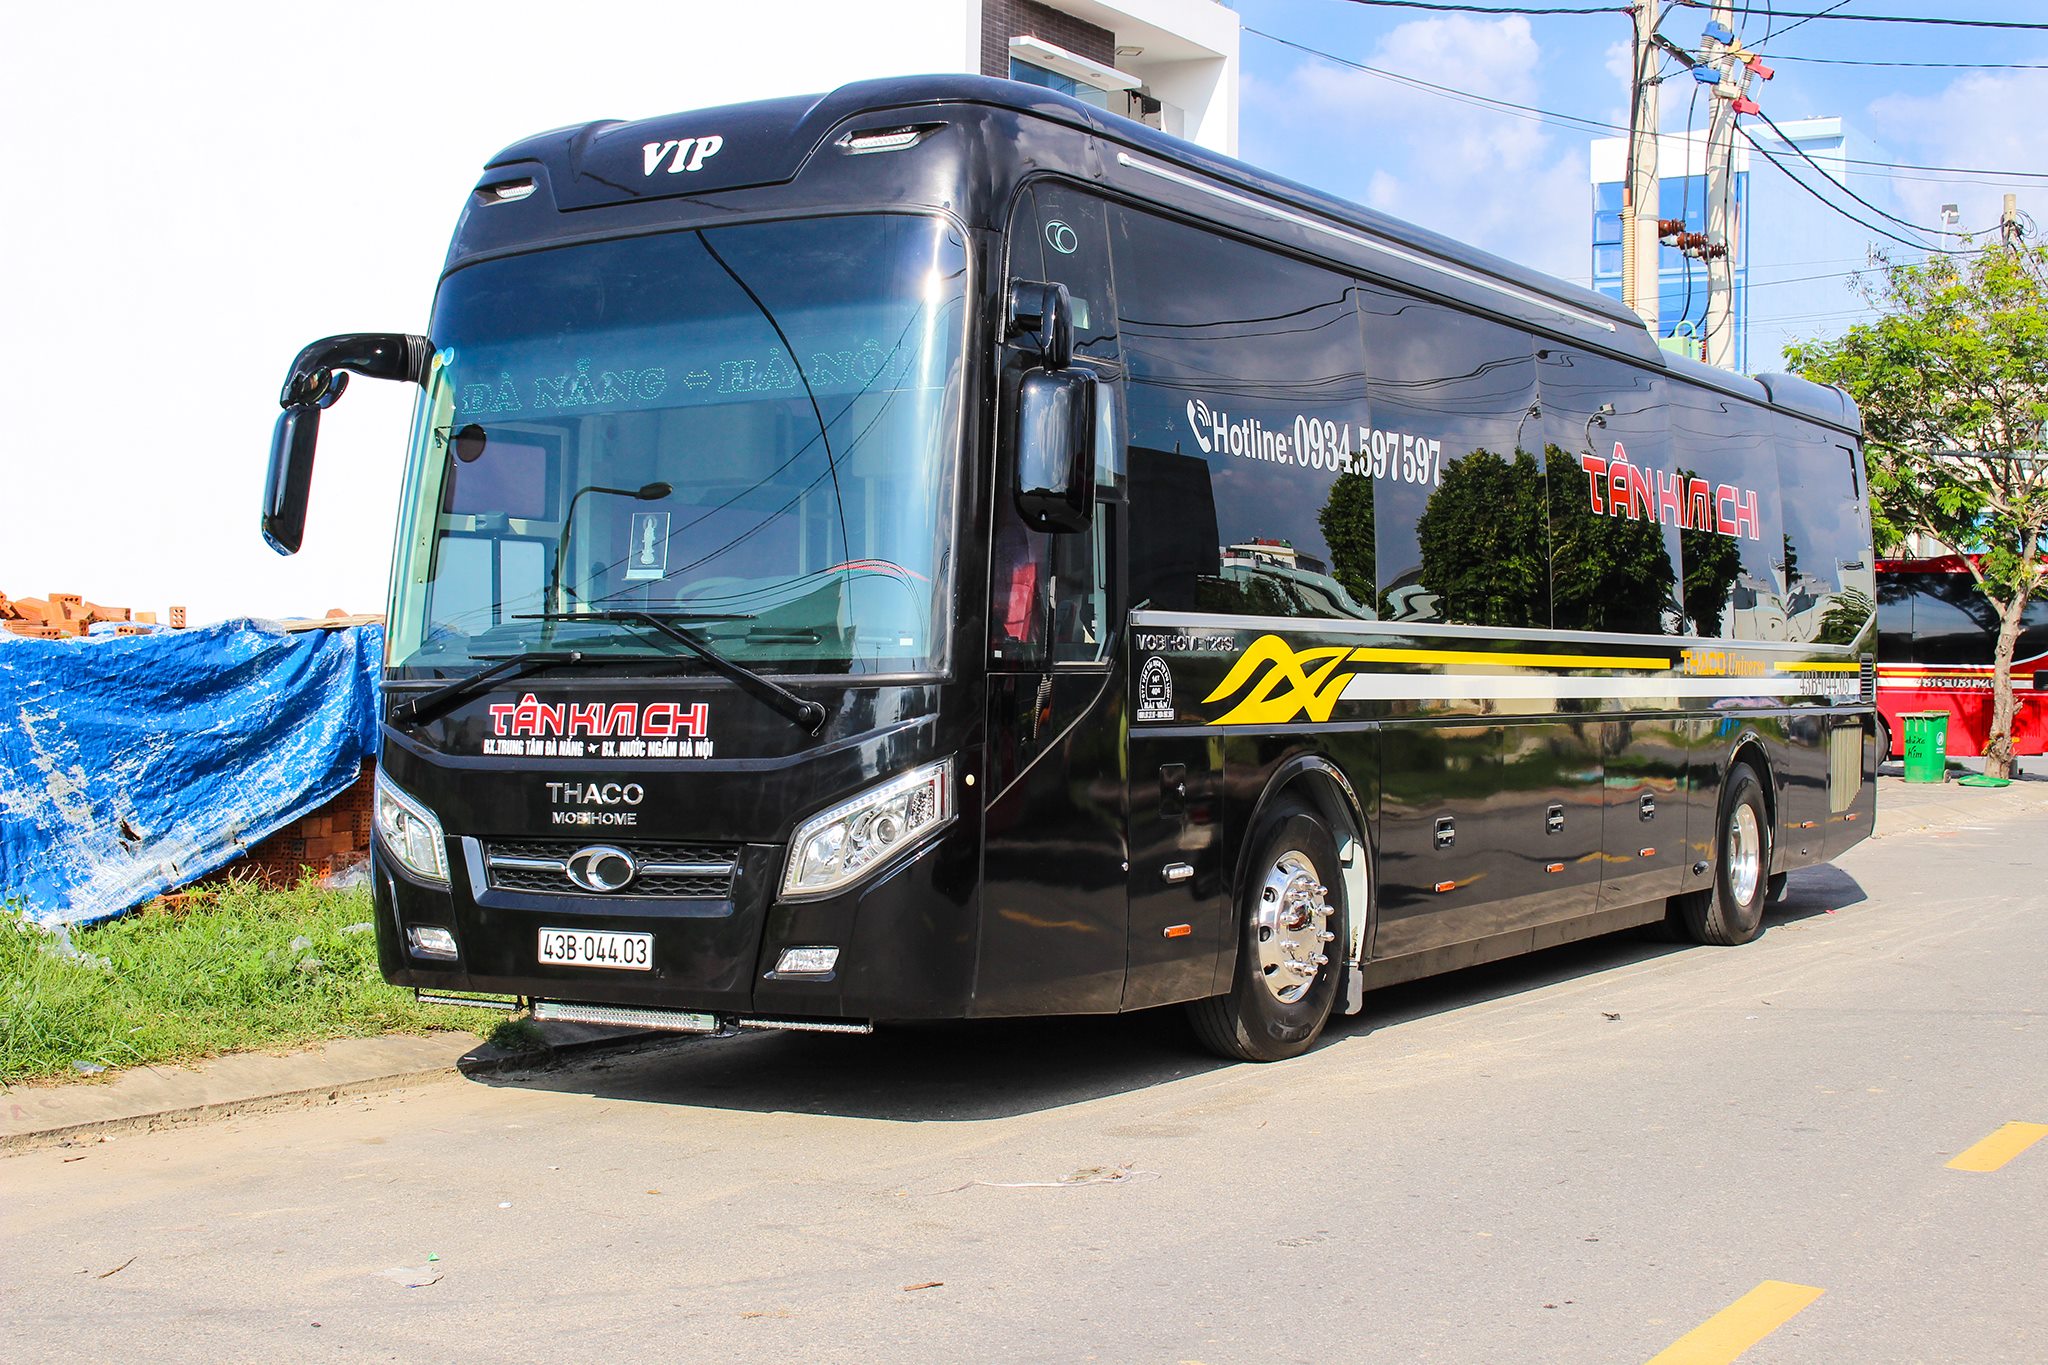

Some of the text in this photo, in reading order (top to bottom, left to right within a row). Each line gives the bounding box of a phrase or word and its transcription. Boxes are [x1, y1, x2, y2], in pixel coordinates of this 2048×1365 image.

[642, 135, 724, 177] VIP
[1581, 441, 1761, 541] TÂN KIM CHI
[1680, 650, 1767, 677] THACO Universe
[489, 693, 710, 738] TÂN KIM CHI
[525, 737, 545, 756] TÂM
[545, 737, 558, 756] ĐÀ
[678, 738, 693, 757] HÀ
[694, 737, 714, 760] NỘI
[545, 782, 644, 806] THACO
[552, 811, 637, 826] MOBIHOME
